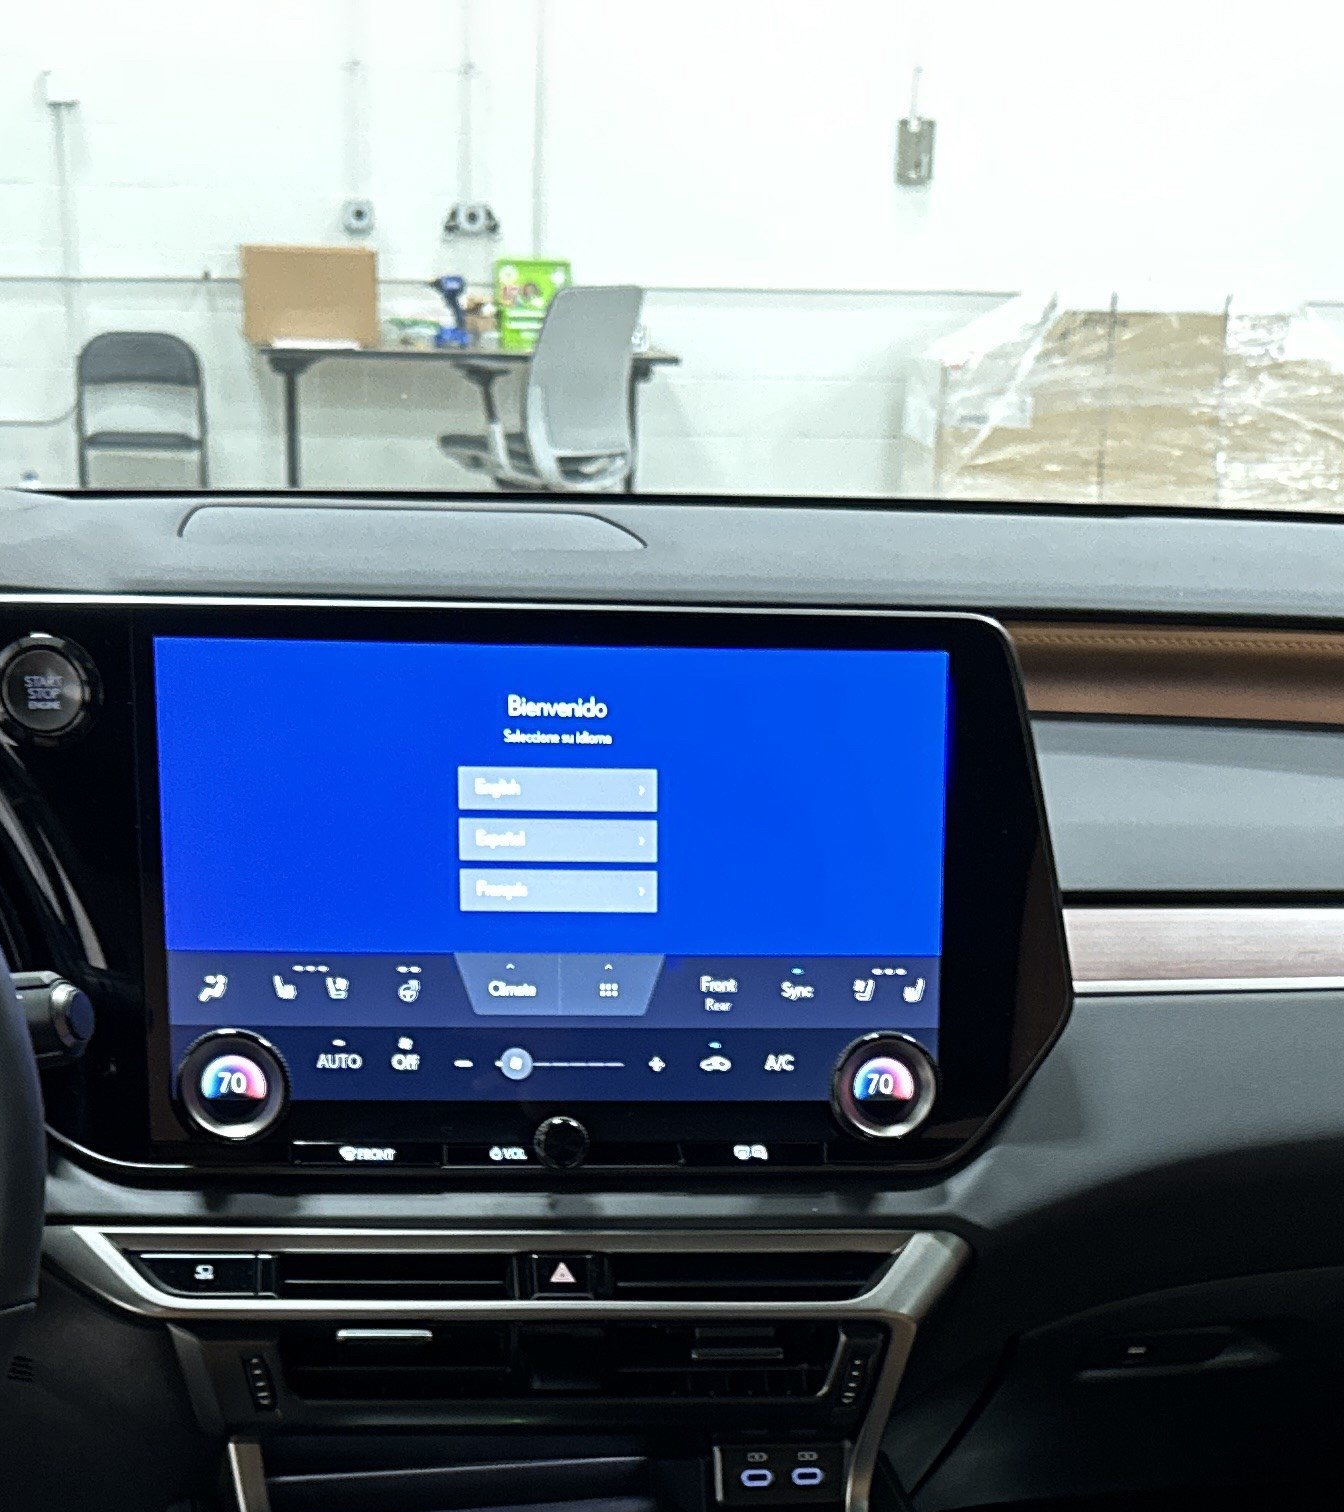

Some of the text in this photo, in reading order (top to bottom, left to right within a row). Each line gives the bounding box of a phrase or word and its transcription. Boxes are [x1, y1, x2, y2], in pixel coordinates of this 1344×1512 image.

[507, 694, 608, 718] Bienvenido
[474, 778, 522, 799] English
[487, 980, 537, 997] Climate
[699, 974, 739, 993] Front
[780, 980, 816, 1001] Sync
[704, 996, 734, 1012] Rear
[316, 1052, 364, 1069] AUTO
[390, 1052, 421, 1071] Off
[763, 1052, 796, 1072] A/C
[217, 1070, 249, 1095] 70
[866, 1072, 895, 1096] 70
